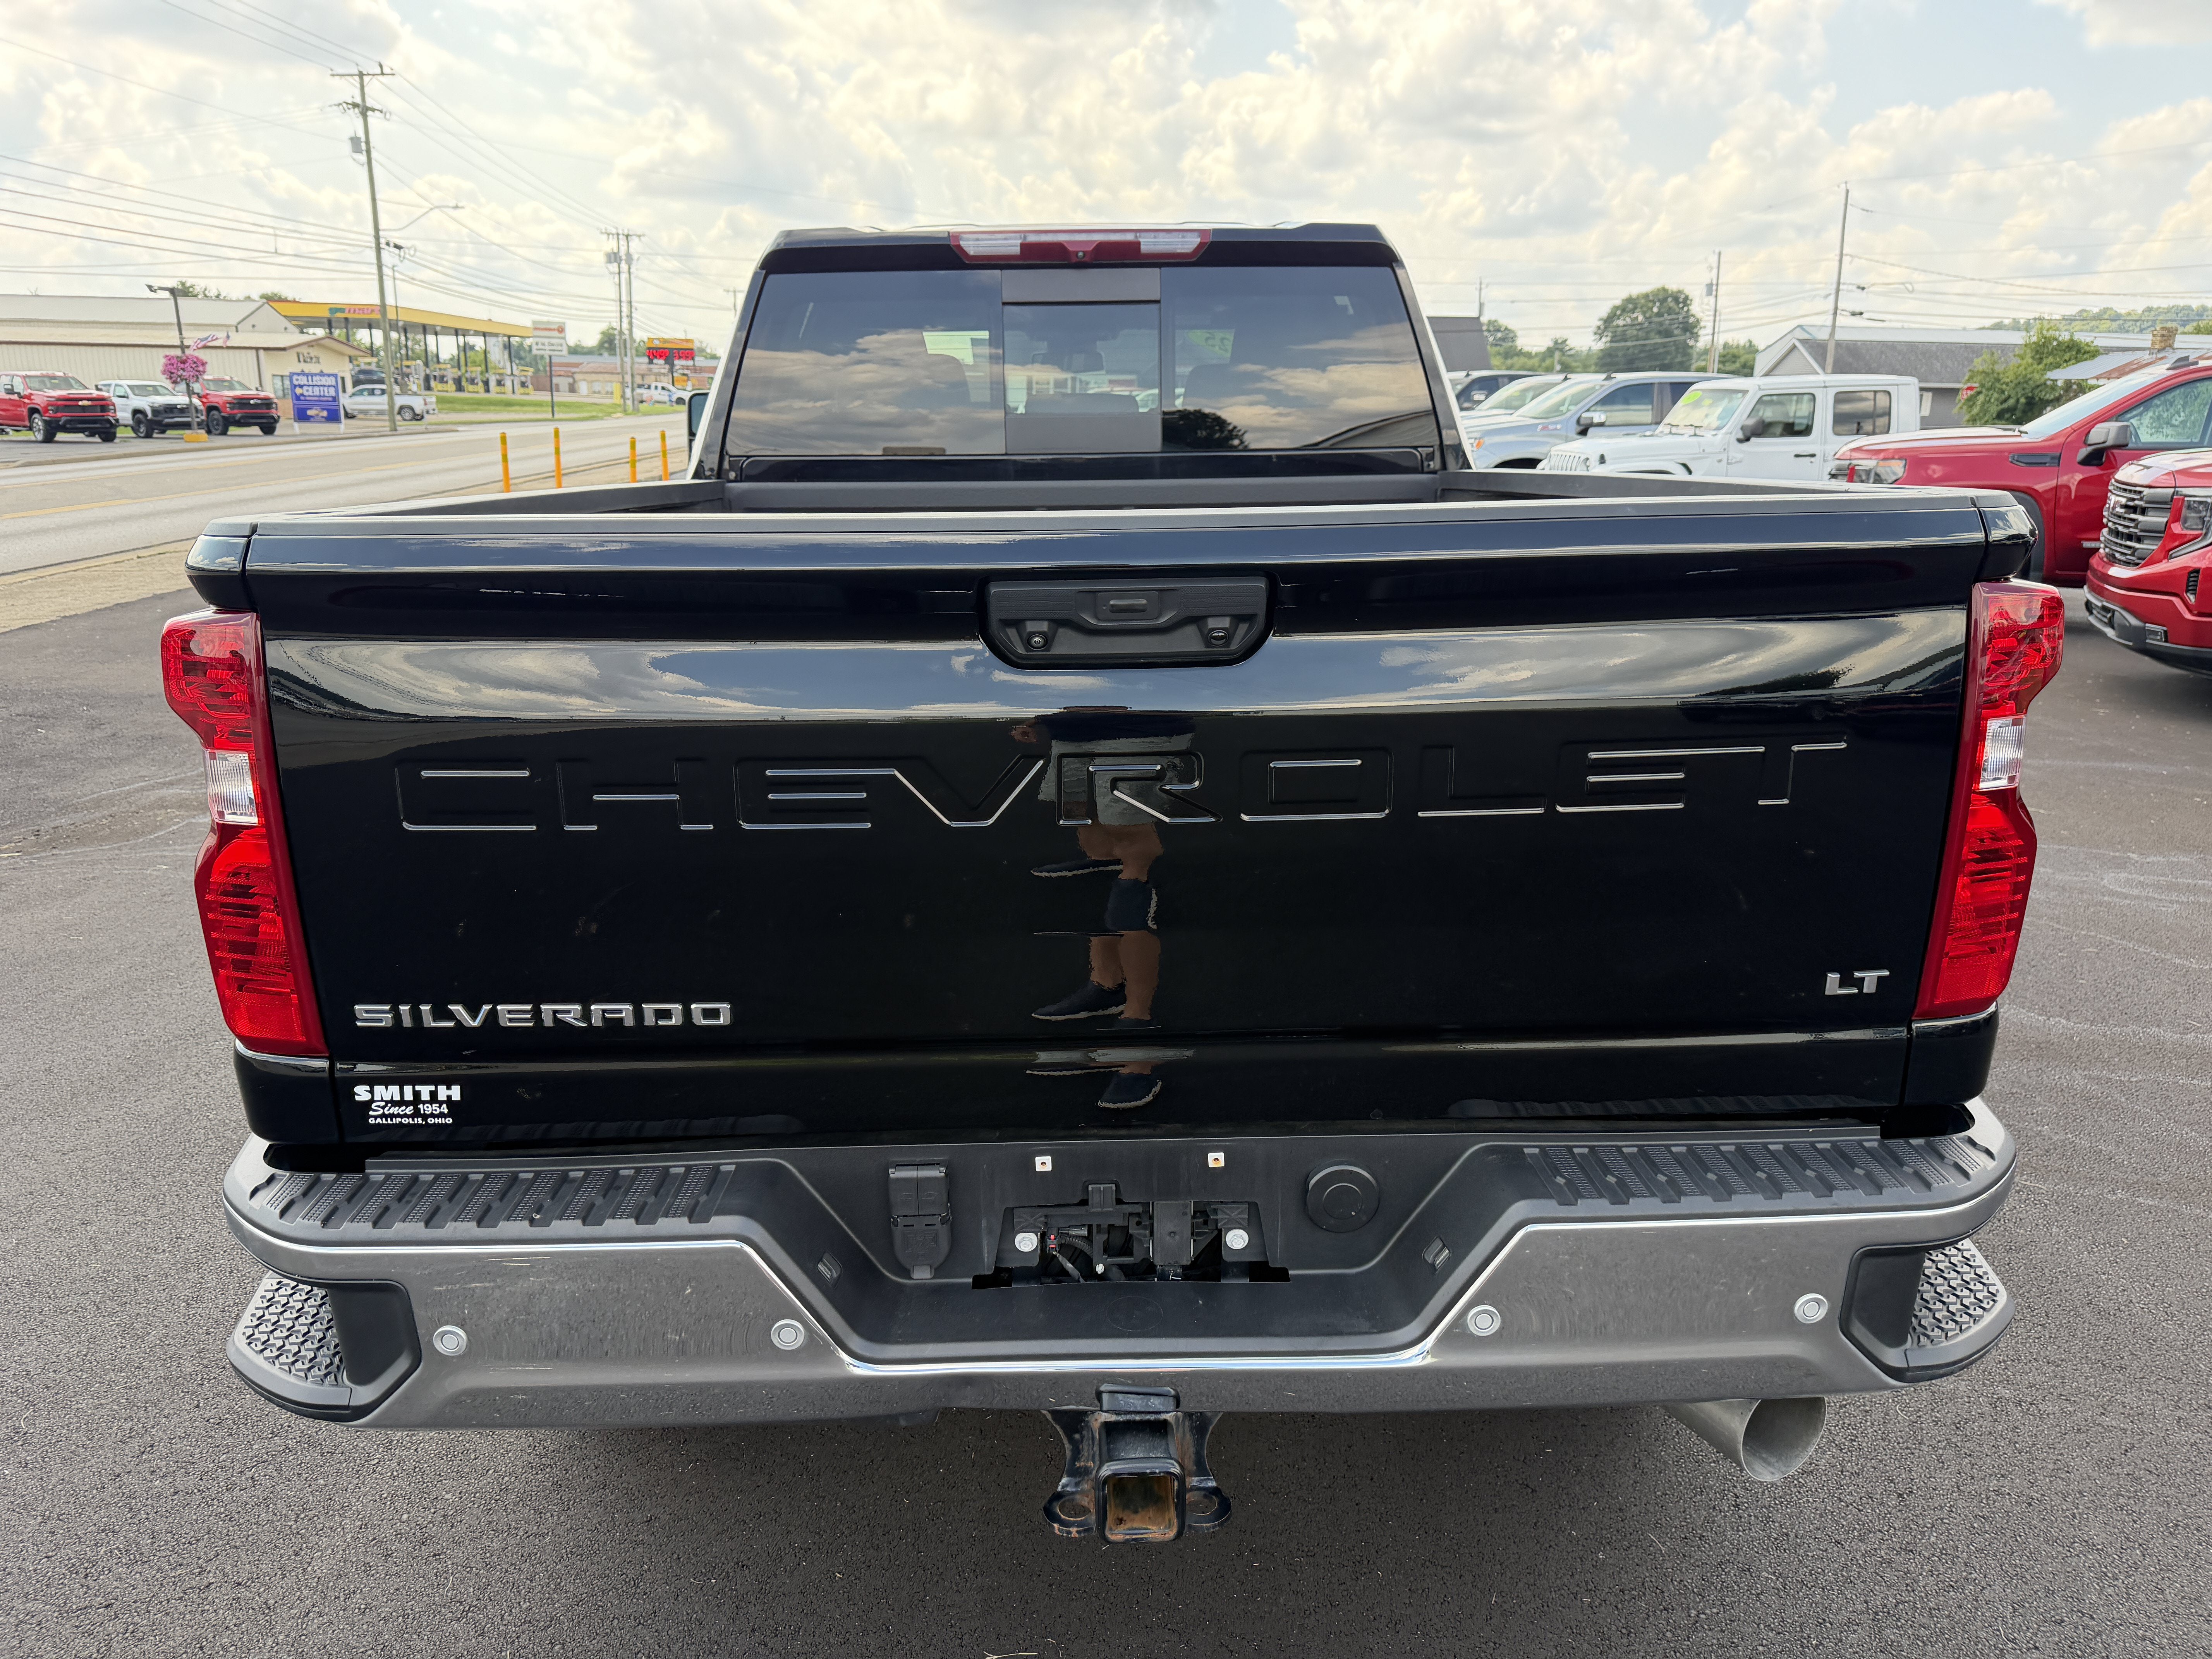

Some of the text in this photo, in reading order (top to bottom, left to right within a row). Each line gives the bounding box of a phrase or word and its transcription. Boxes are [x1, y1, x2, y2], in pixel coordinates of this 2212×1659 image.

[302, 386, 336, 397] CENTER
[394, 730, 1850, 831] CHEVROLET
[1824, 969, 1890, 995] LT
[354, 1003, 732, 1028] SILVERADO
[354, 1085, 461, 1101] SMITH
[369, 1102, 448, 1115] Since 1954
